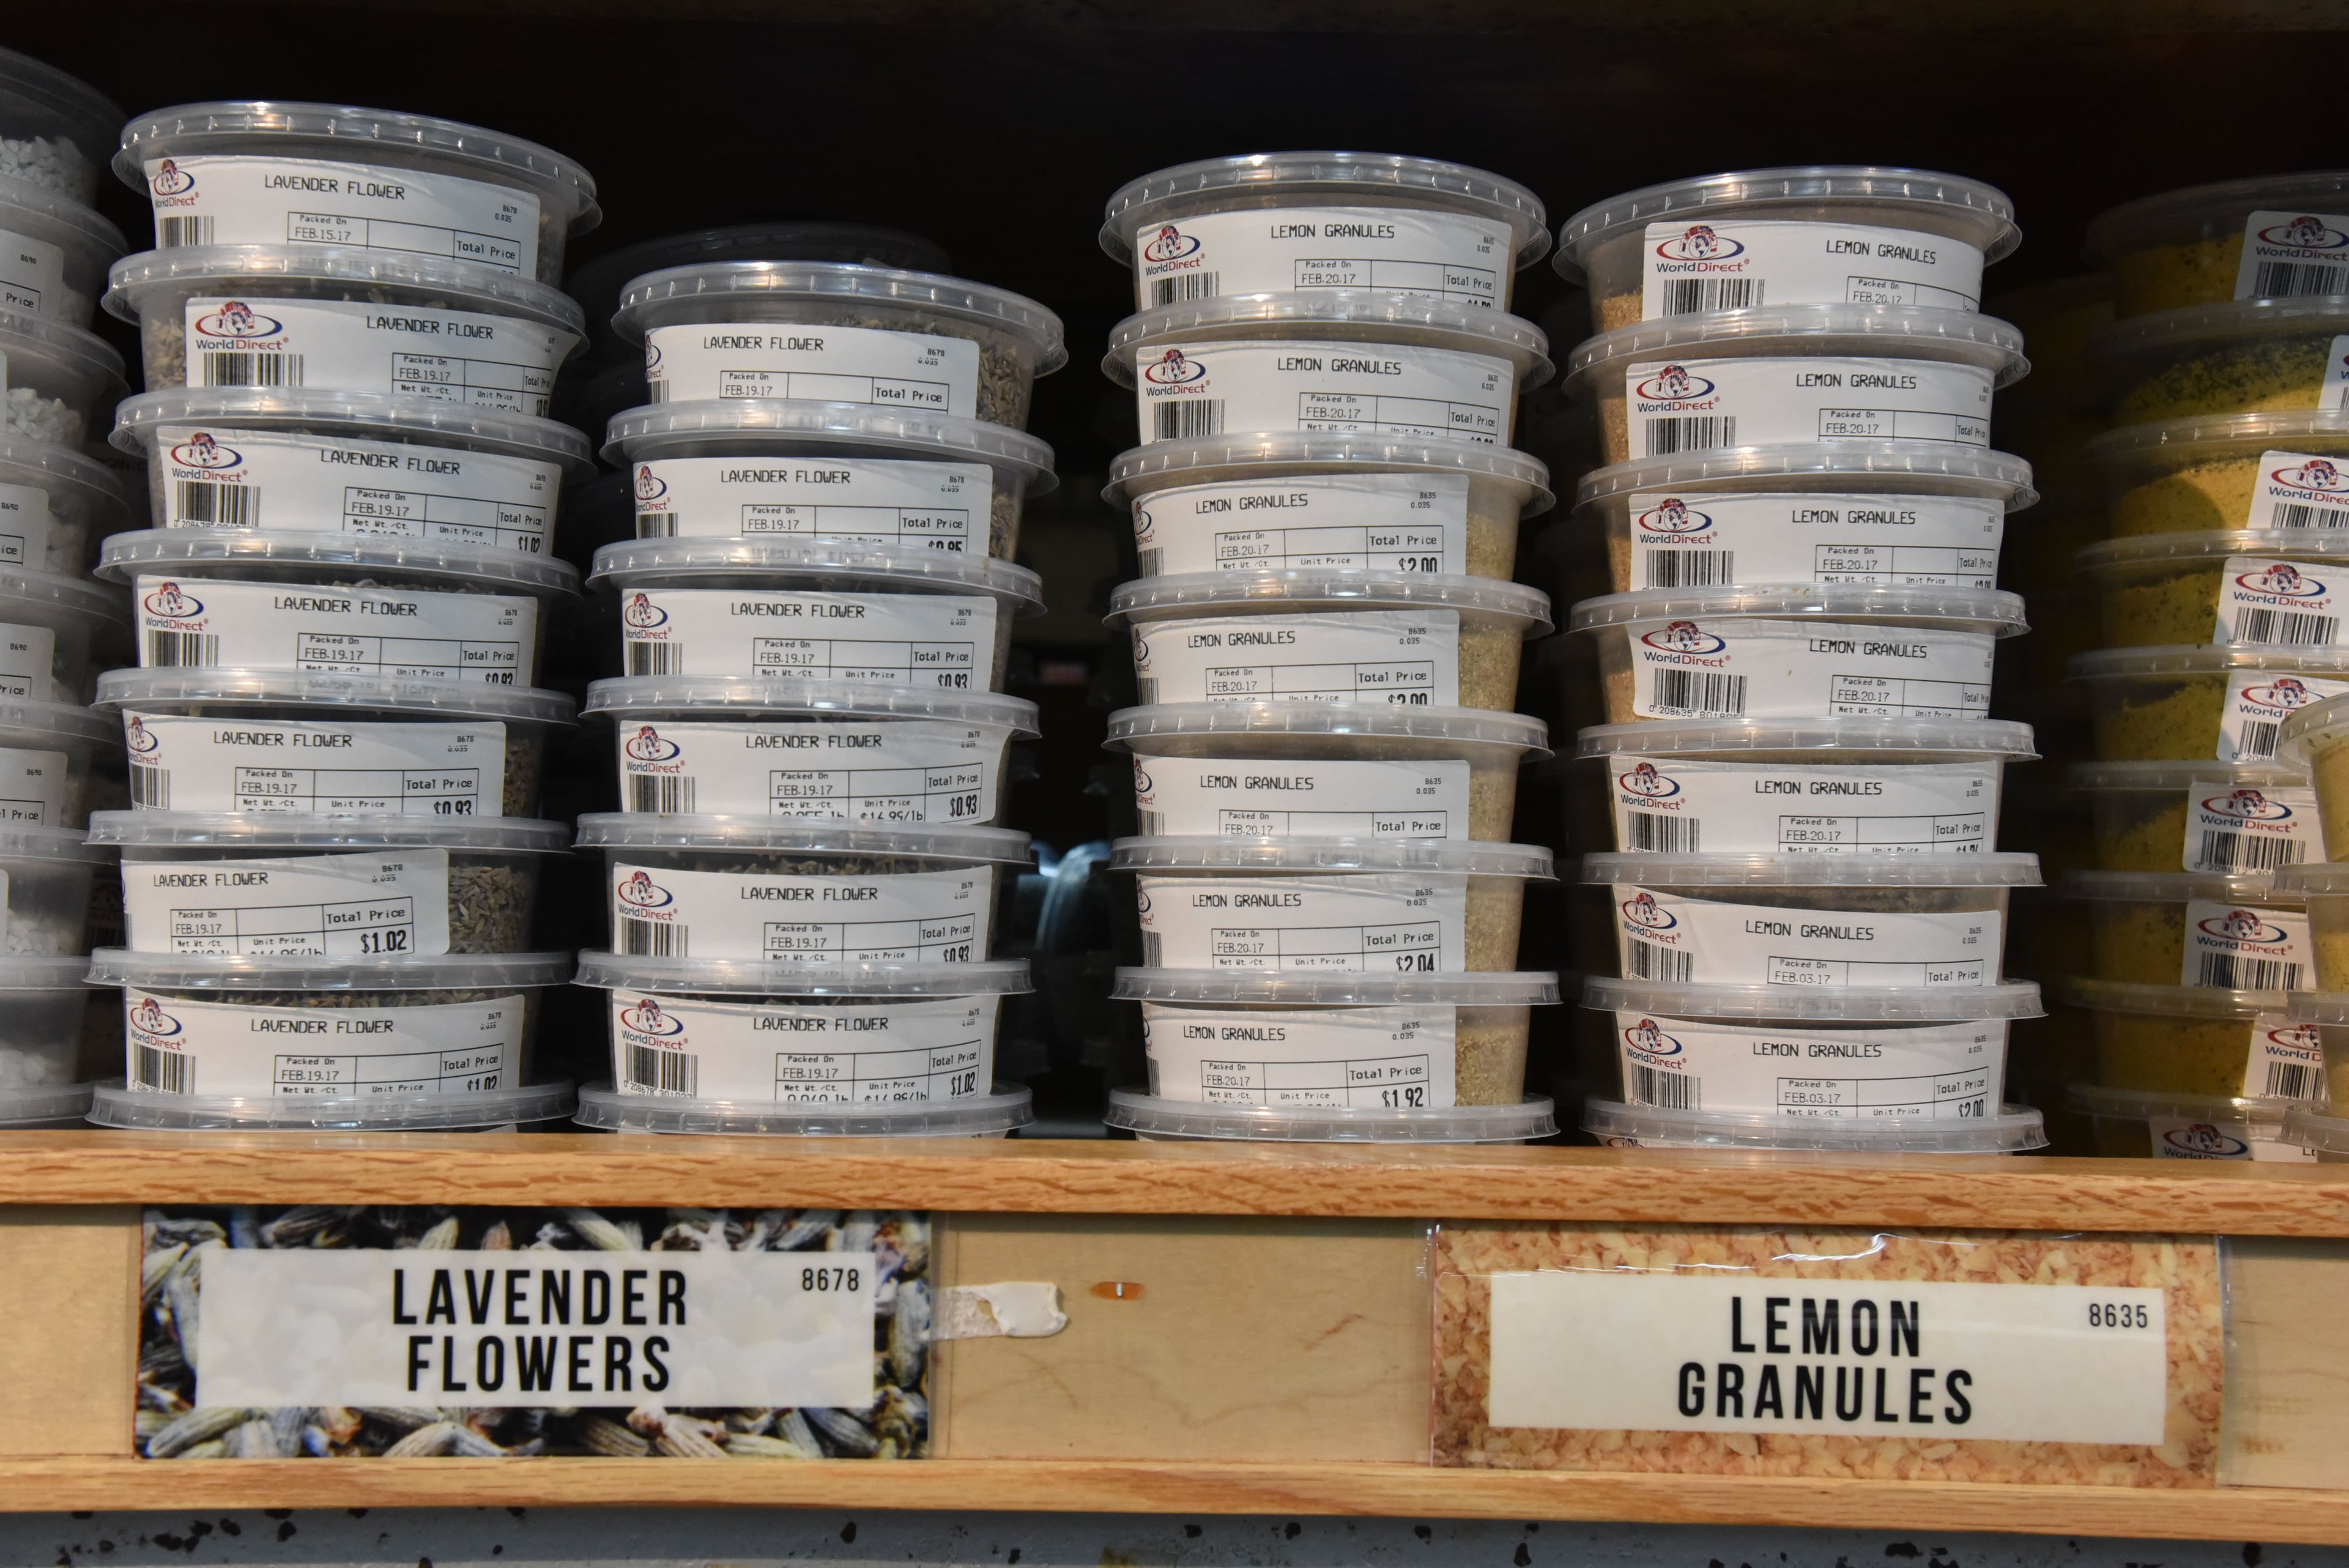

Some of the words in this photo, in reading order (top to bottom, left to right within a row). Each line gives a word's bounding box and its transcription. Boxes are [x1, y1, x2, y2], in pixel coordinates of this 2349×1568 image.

[265, 174, 338, 193] LAVENDER
[347, 182, 405, 201] FLOWER
[295, 228, 351, 242] FEB.15.17
[1271, 225, 1316, 239] LEMON
[1324, 224, 1395, 239] GRANULES
[456, 240, 484, 253] Total
[489, 245, 515, 260] Price
[1827, 240, 1871, 256] LEMON
[1878, 245, 1936, 264] GRANULES
[1301, 273, 1356, 284] FEB.20.17
[6, 293, 34, 308] Price
[1853, 291, 1902, 305] FEB.20.17
[366, 316, 439, 333] LAVENDER
[447, 322, 493, 340] FLOWER
[704, 336, 762, 349] LAVENDER
[770, 337, 824, 351] FLOWER
[1278, 358, 1323, 371] LEMON
[1332, 359, 1401, 375] GRANULES
[399, 368, 451, 381] FEB.19.17
[1797, 373, 1842, 388] LEMON
[1850, 374, 1917, 390] GRANULES
[725, 384, 773, 396] FEB.19.17
[875, 387, 907, 399] Total
[912, 390, 943, 403] Price
[1306, 407, 1361, 418] FEB.20.17
[1826, 423, 1879, 434] FEB.20.17
[321, 450, 399, 469] LAVENDER
[407, 457, 461, 475] FLOWER
[721, 470, 788, 483] LAVENDER
[795, 470, 851, 484] FLOWER
[351, 502, 409, 517] FEB.19.17
[1195, 497, 1232, 515] LEMON
[1239, 493, 1308, 511] GRANULES
[748, 519, 800, 530] FEB.19.17
[1792, 510, 1839, 524] LEMON
[1848, 510, 1916, 525] GRANULES
[1370, 535, 1400, 546] Total
[1407, 534, 1437, 546] Price
[1221, 544, 1270, 557] FEB.20.17
[1823, 560, 1877, 570] FEB.20.17
[275, 596, 351, 613] LAVENDER
[361, 601, 417, 616] FLOWER
[731, 603, 803, 617] LAVENDER
[811, 604, 865, 618] FLOWER
[1188, 634, 1222, 648] LEMON
[1228, 631, 1296, 646] GRANULES
[304, 648, 364, 661] FEB.19.17
[1809, 639, 1855, 654] LEMON
[1864, 643, 1928, 659] GRANULES
[760, 652, 814, 664] FEB.19.17
[1357, 672, 1390, 683] Total
[1397, 671, 1427, 682] Price
[1212, 681, 1257, 693] FEB.20.17
[1838, 689, 1890, 702] FEB.20.17
[213, 731, 284, 746] LAVENDER
[293, 734, 352, 748] FLOWER
[746, 735, 819, 749] LAVENDER
[828, 735, 882, 748] FLOWER
[928, 776, 952, 787] Total
[957, 773, 979, 786] Price
[1200, 776, 1238, 789] LEMON
[1245, 776, 1314, 790] GRANULES
[242, 782, 297, 795] FEB.19.17
[777, 784, 833, 795] FEB.19.17
[1755, 781, 1802, 795] LEMON
[1810, 781, 1882, 795] GRANULES
[949, 793, 978, 817] $0.93
[12, 809, 39, 820] Price
[1225, 823, 1273, 835] FEB.20.17
[1786, 830, 1841, 841] FEB.20.17
[382, 864, 403, 872] 8678
[153, 874, 207, 887] LAVENDER
[215, 872, 269, 886] FLOWER
[741, 886, 814, 901] LAVENDER
[823, 888, 878, 901] FLOWER
[1192, 894, 1228, 907] LEMON
[1234, 893, 1302, 907] GRANULES
[326, 912, 362, 925] Total
[369, 907, 405, 922] Price
[176, 923, 221, 934] FEB.19.17
[1746, 921, 1792, 937] LEMON
[1800, 925, 1874, 941] GRANULES
[361, 930, 407, 954] $1.02
[771, 937, 826, 948] FEB.19.17
[1217, 942, 1264, 953] FEB.20.17
[1775, 972, 1831, 984] FEB.03.17
[1928, 971, 1953, 983] Total
[1958, 968, 1979, 982] Price
[251, 1019, 327, 1033] LAVENDER
[336, 1020, 393, 1033] FLOWER
[753, 1017, 826, 1031] LAVENDER
[836, 1017, 889, 1030] FLOWER
[1183, 1025, 1215, 1039] LEMON
[1222, 1027, 1285, 1041] GRANULES
[1753, 1042, 1800, 1057] LEMON
[1808, 1044, 1882, 1058] GRANULES
[443, 1060, 470, 1071] Total
[475, 1054, 499, 1067] Price
[932, 1056, 955, 1068] Total
[959, 1051, 978, 1063] Price
[281, 1069, 340, 1081] FEB.19.17
[782, 1068, 839, 1079] FEB.19.17
[1349, 1068, 1382, 1081] Total
[1389, 1064, 1422, 1077] Price
[951, 1072, 975, 1096] $1.02
[1206, 1075, 1250, 1087] FEB.20.17
[1784, 1092, 1841, 1104] FEB.03.17
[801, 1268, 860, 1292] 8678
[392, 1269, 688, 1326] LAVENDER
[2088, 1303, 2149, 1328] 8635
[1731, 1297, 1921, 1357] LEMON
[407, 1334, 671, 1392] FLOWERS
[1677, 1362, 1973, 1425] GRANULES
